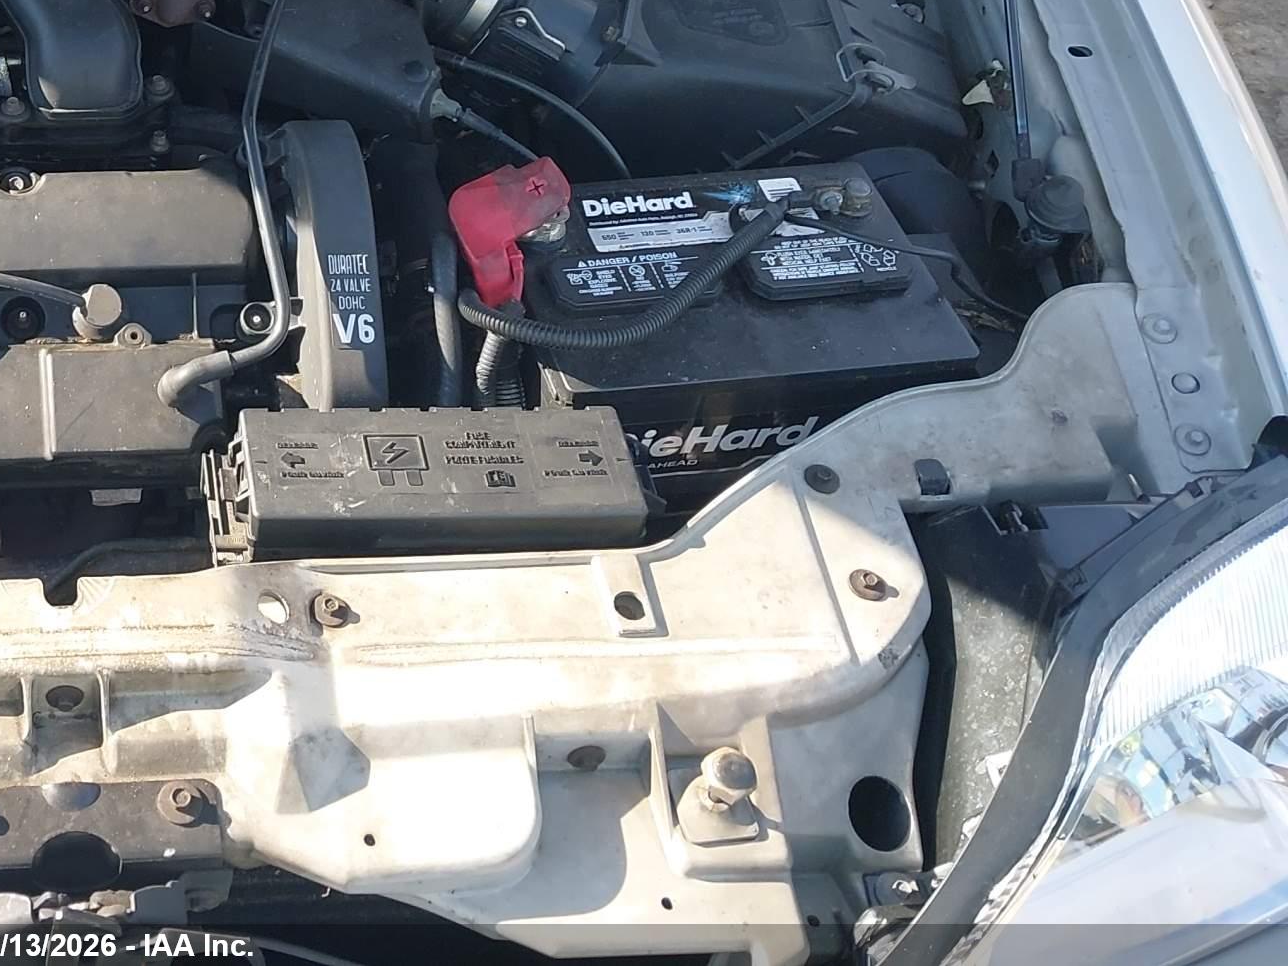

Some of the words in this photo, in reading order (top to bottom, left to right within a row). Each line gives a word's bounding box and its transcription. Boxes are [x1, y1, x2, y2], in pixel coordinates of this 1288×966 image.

[582, 192, 694, 217] DieHard
[328, 254, 370, 274] DURATEC
[588, 257, 630, 267] DANGER
[639, 252, 678, 262] POISON
[331, 279, 341, 292] 24
[344, 278, 372, 292] VALVE
[338, 296, 366, 310] DOHC
[332, 314, 375, 344] V6
[624, 416, 819, 458] ieHard
[648, 459, 698, 469] AHEAD
